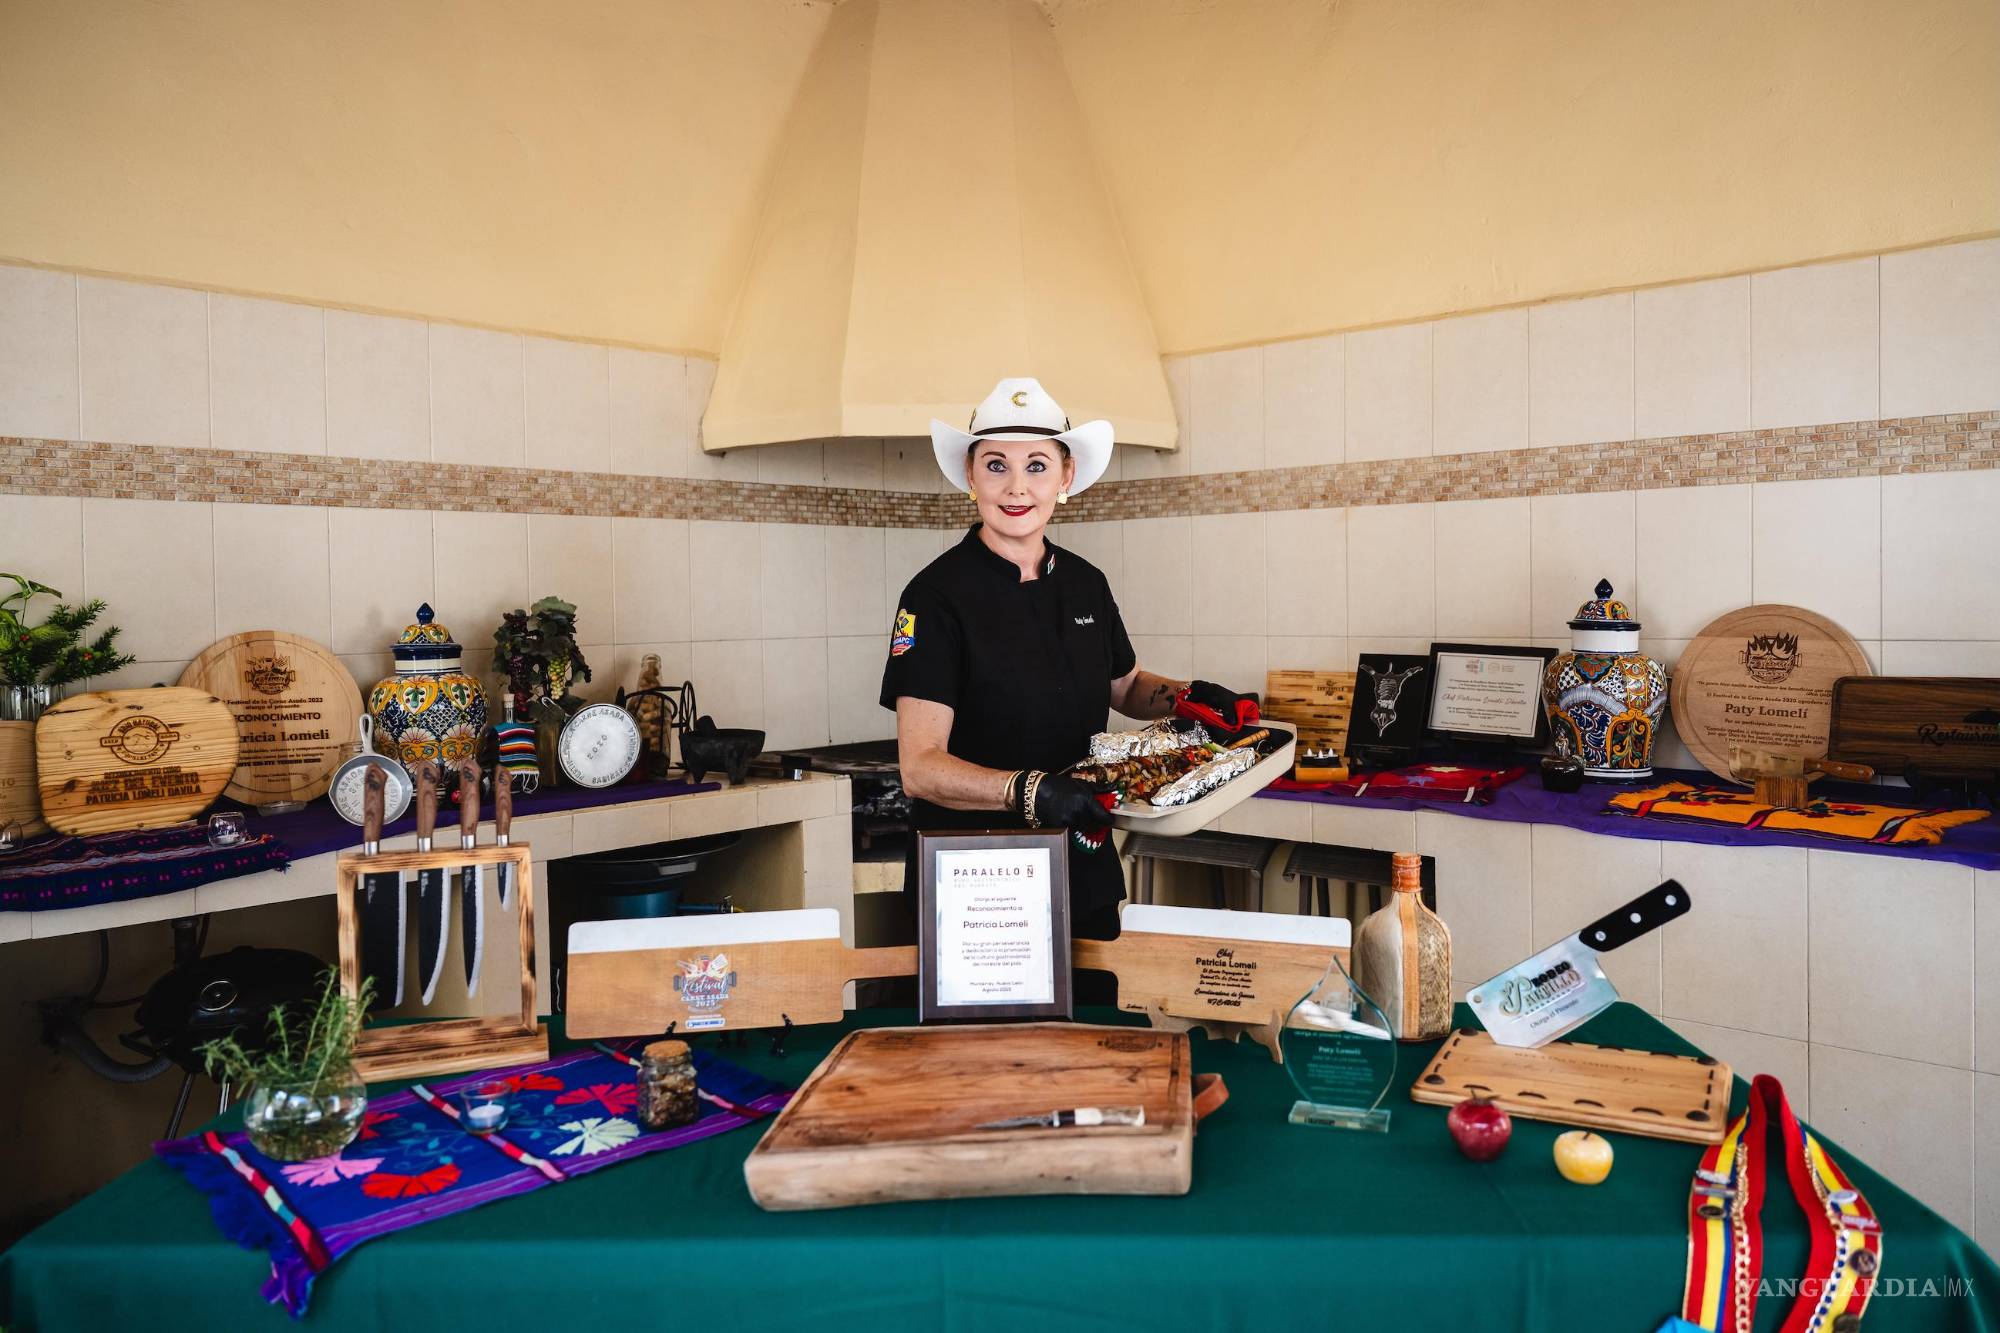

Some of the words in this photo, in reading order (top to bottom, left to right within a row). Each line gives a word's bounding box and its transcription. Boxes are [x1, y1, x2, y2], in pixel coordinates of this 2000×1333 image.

[1725, 703, 1755, 717] Paty
[1760, 706, 1808, 719] Lomelí
[280, 729, 330, 742] Lomeli
[86, 792, 130, 805] PATRICIA
[133, 788, 165, 800] LOMELI
[168, 784, 202, 797] DAVILA
[954, 867, 1020, 877] PARALELO
[963, 920, 998, 929] Patricia
[1216, 948, 1235, 960] Chef
[1196, 958, 1227, 967] Patricia
[1228, 960, 1257, 970] Lomeli
[1531, 961, 1572, 987] RODEO
[1318, 1046, 1334, 1055] Paty
